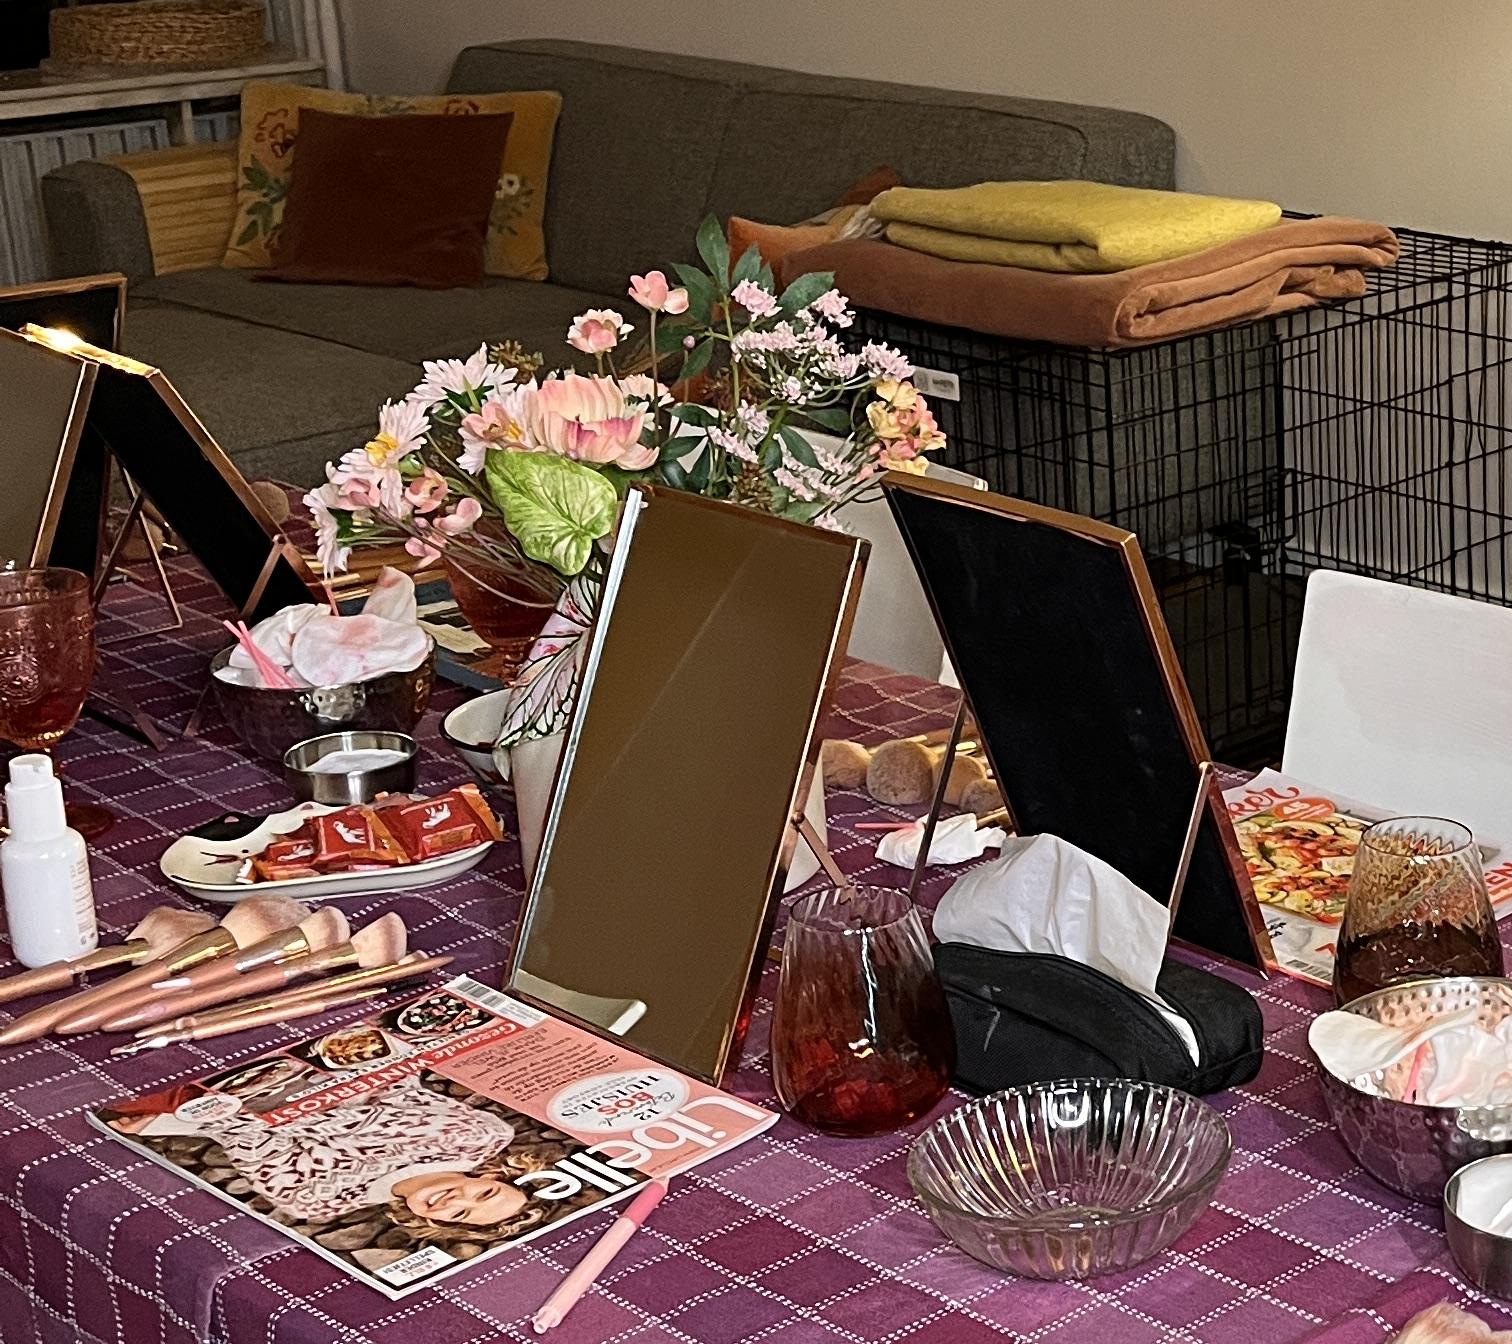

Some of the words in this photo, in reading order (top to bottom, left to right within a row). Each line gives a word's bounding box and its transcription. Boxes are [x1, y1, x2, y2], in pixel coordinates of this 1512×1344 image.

[427, 1021, 523, 1060] Gezonde
[264, 1055, 436, 1124] WINTERKOST
[557, 1073, 663, 1120] HUISJES
[593, 1089, 655, 1117] BOS
[630, 1106, 662, 1121] 12
[514, 1095, 769, 1197] Libelle
